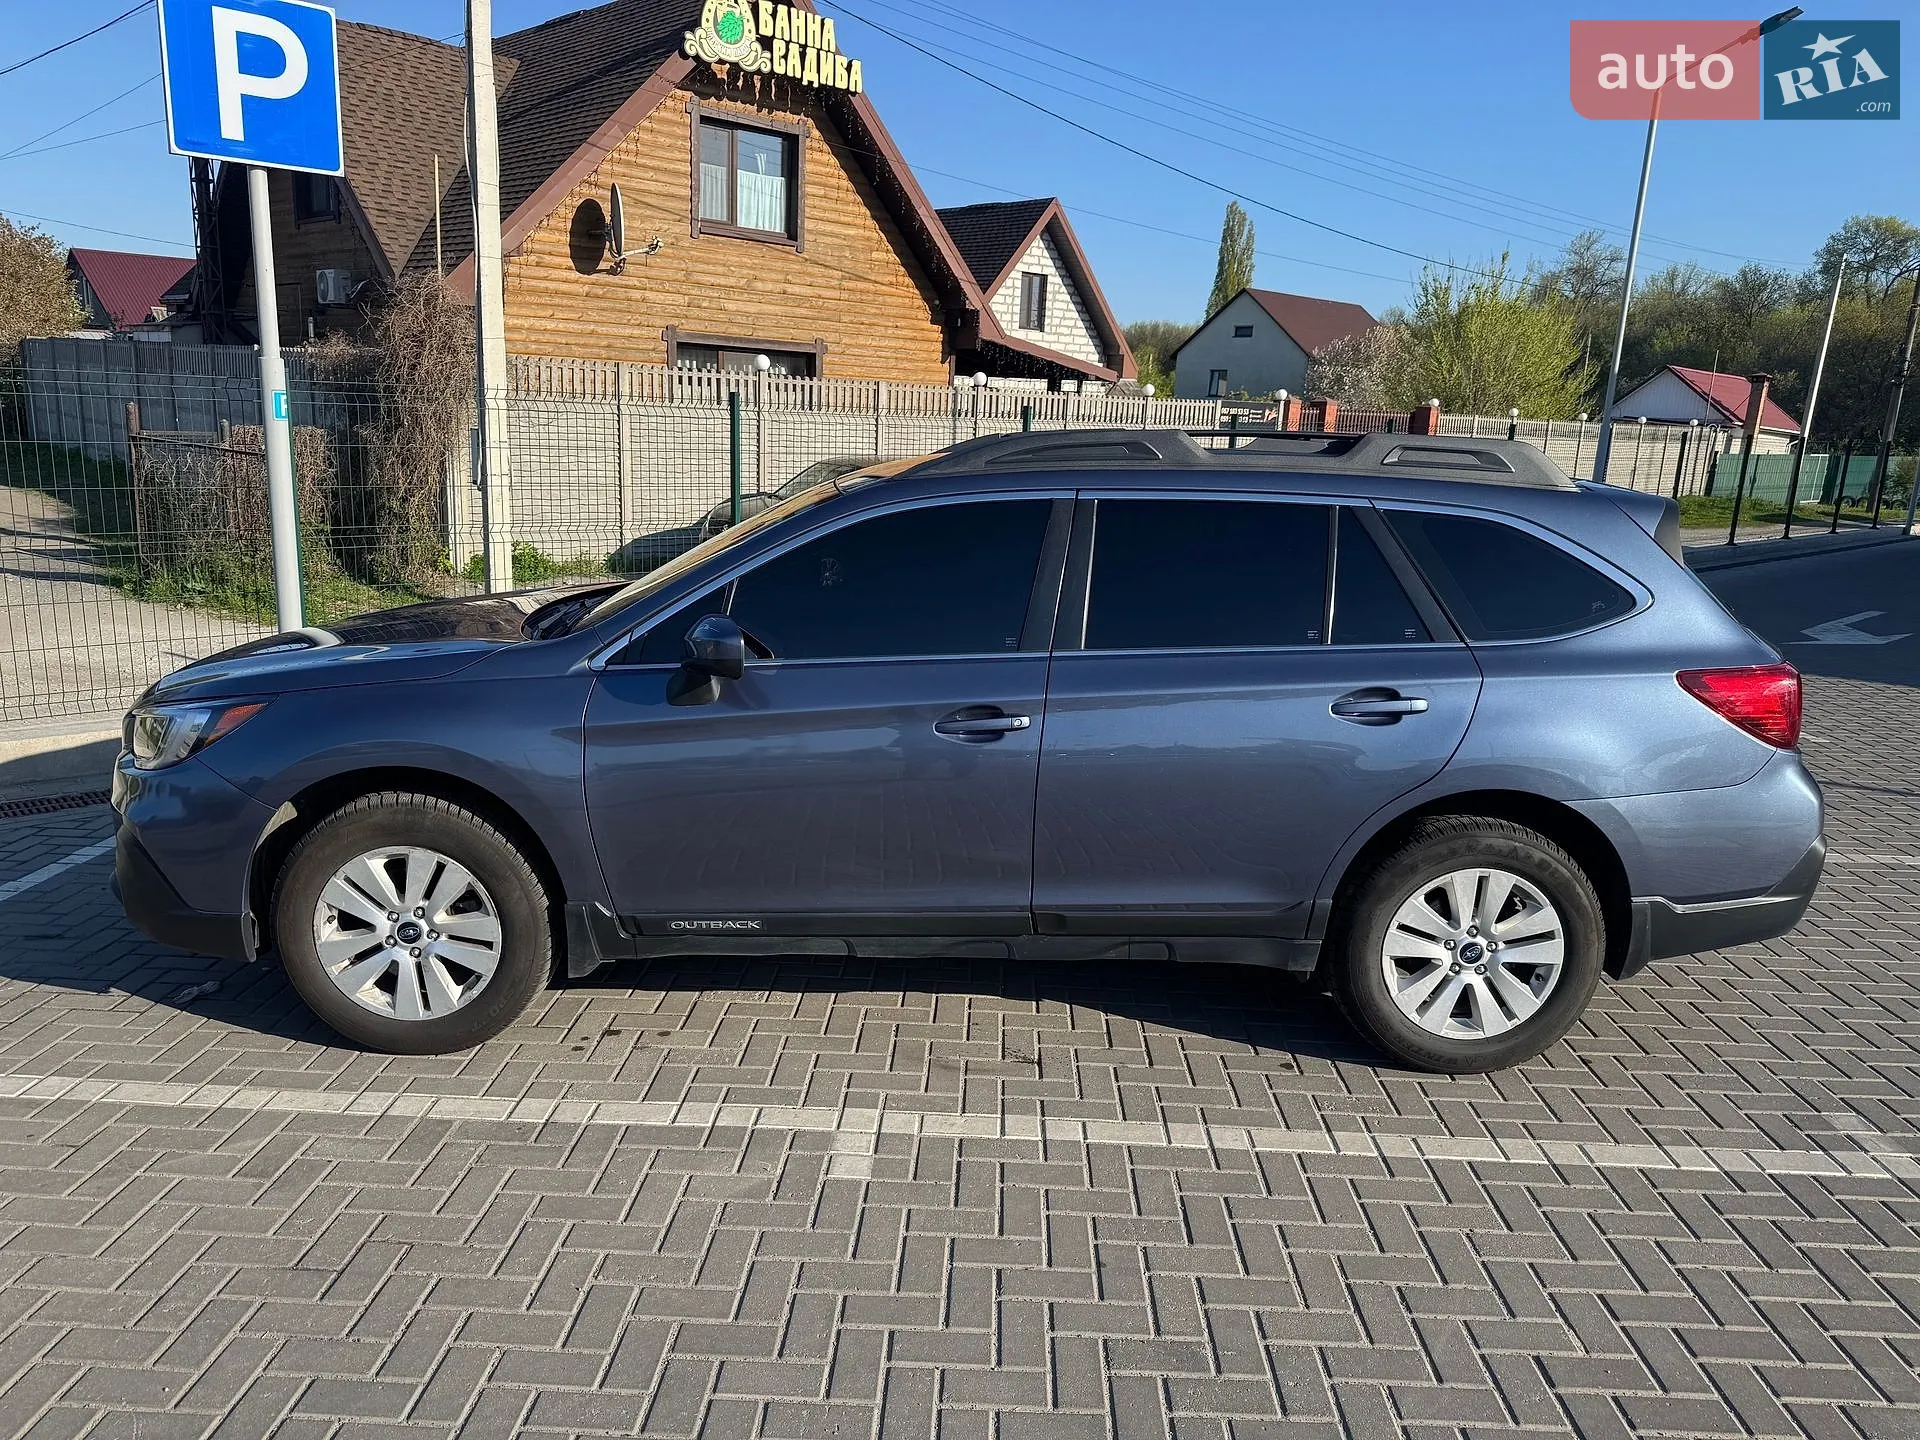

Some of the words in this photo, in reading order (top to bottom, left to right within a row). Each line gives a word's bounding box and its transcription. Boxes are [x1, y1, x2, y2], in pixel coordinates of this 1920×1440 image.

[758, 0, 836, 51] БАННА
[211, 5, 309, 142] P
[670, 920, 761, 929] OUTBACK
